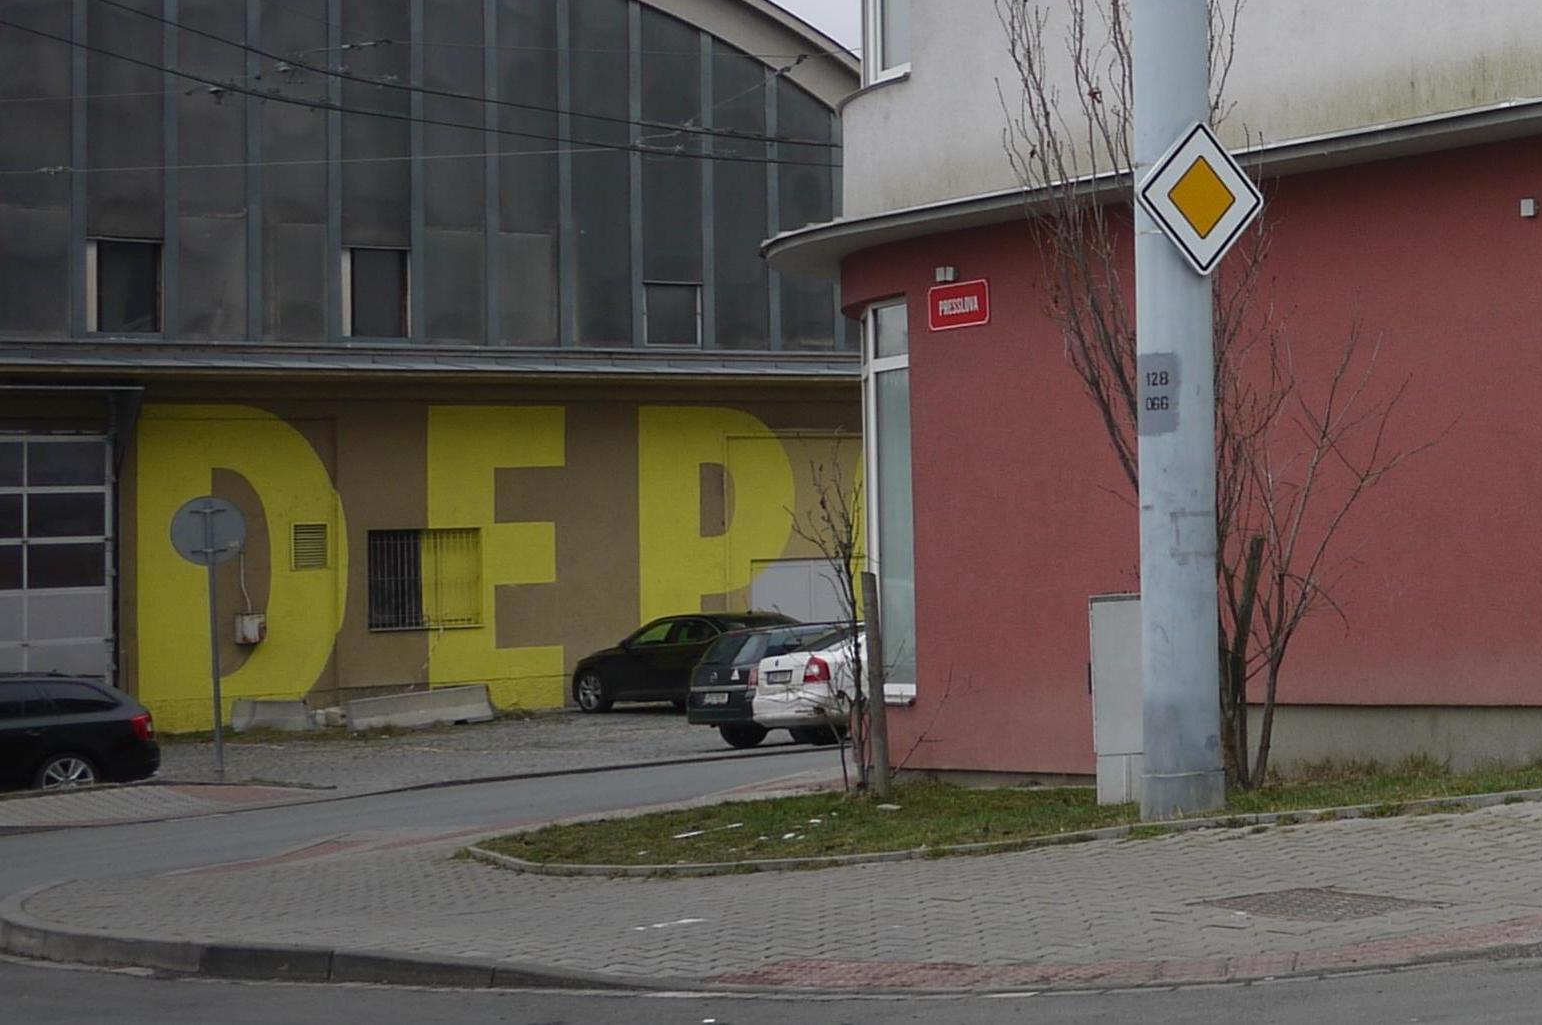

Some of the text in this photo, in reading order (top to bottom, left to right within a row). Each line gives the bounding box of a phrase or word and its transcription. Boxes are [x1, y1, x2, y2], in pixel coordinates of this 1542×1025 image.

[1146, 368, 1169, 386] 128
[1145, 395, 1169, 411] 066
[136, 404, 867, 734] DEP
